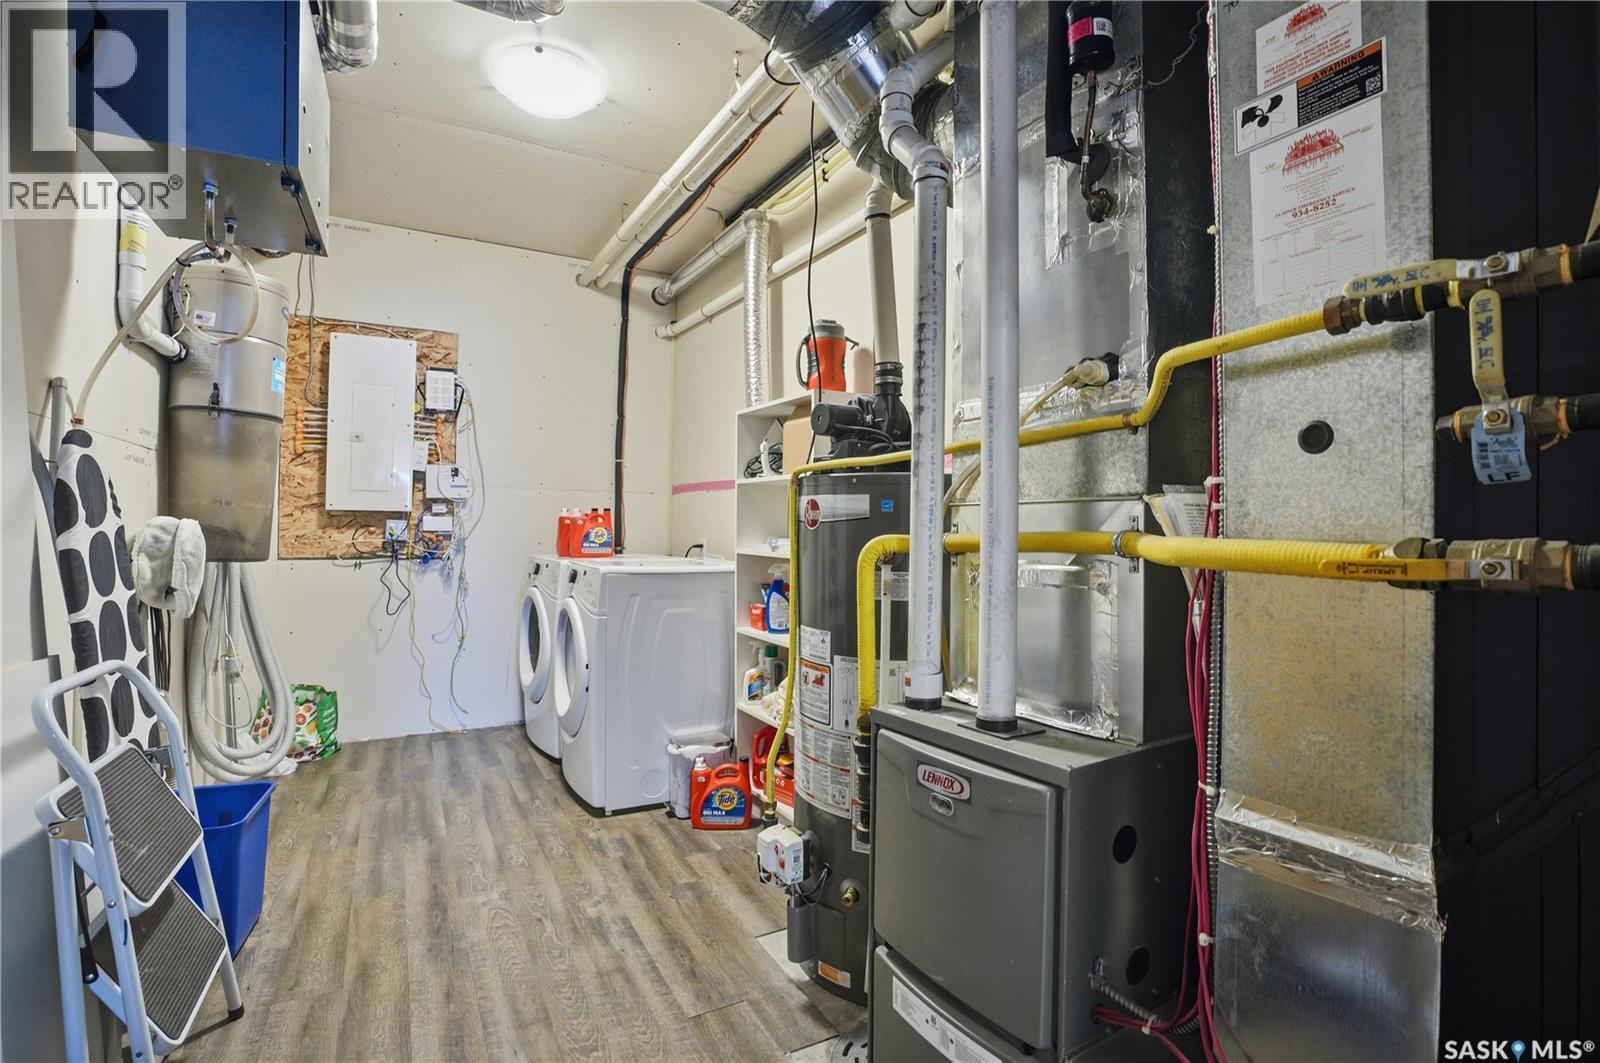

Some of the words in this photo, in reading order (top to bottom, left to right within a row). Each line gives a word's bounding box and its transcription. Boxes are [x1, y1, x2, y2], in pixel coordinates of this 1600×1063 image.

[1320, 50, 1365, 76] WARNING
[1488, 471, 1520, 482] LF
[922, 769, 956, 792] LENNOX
[718, 794, 734, 806] Tide
